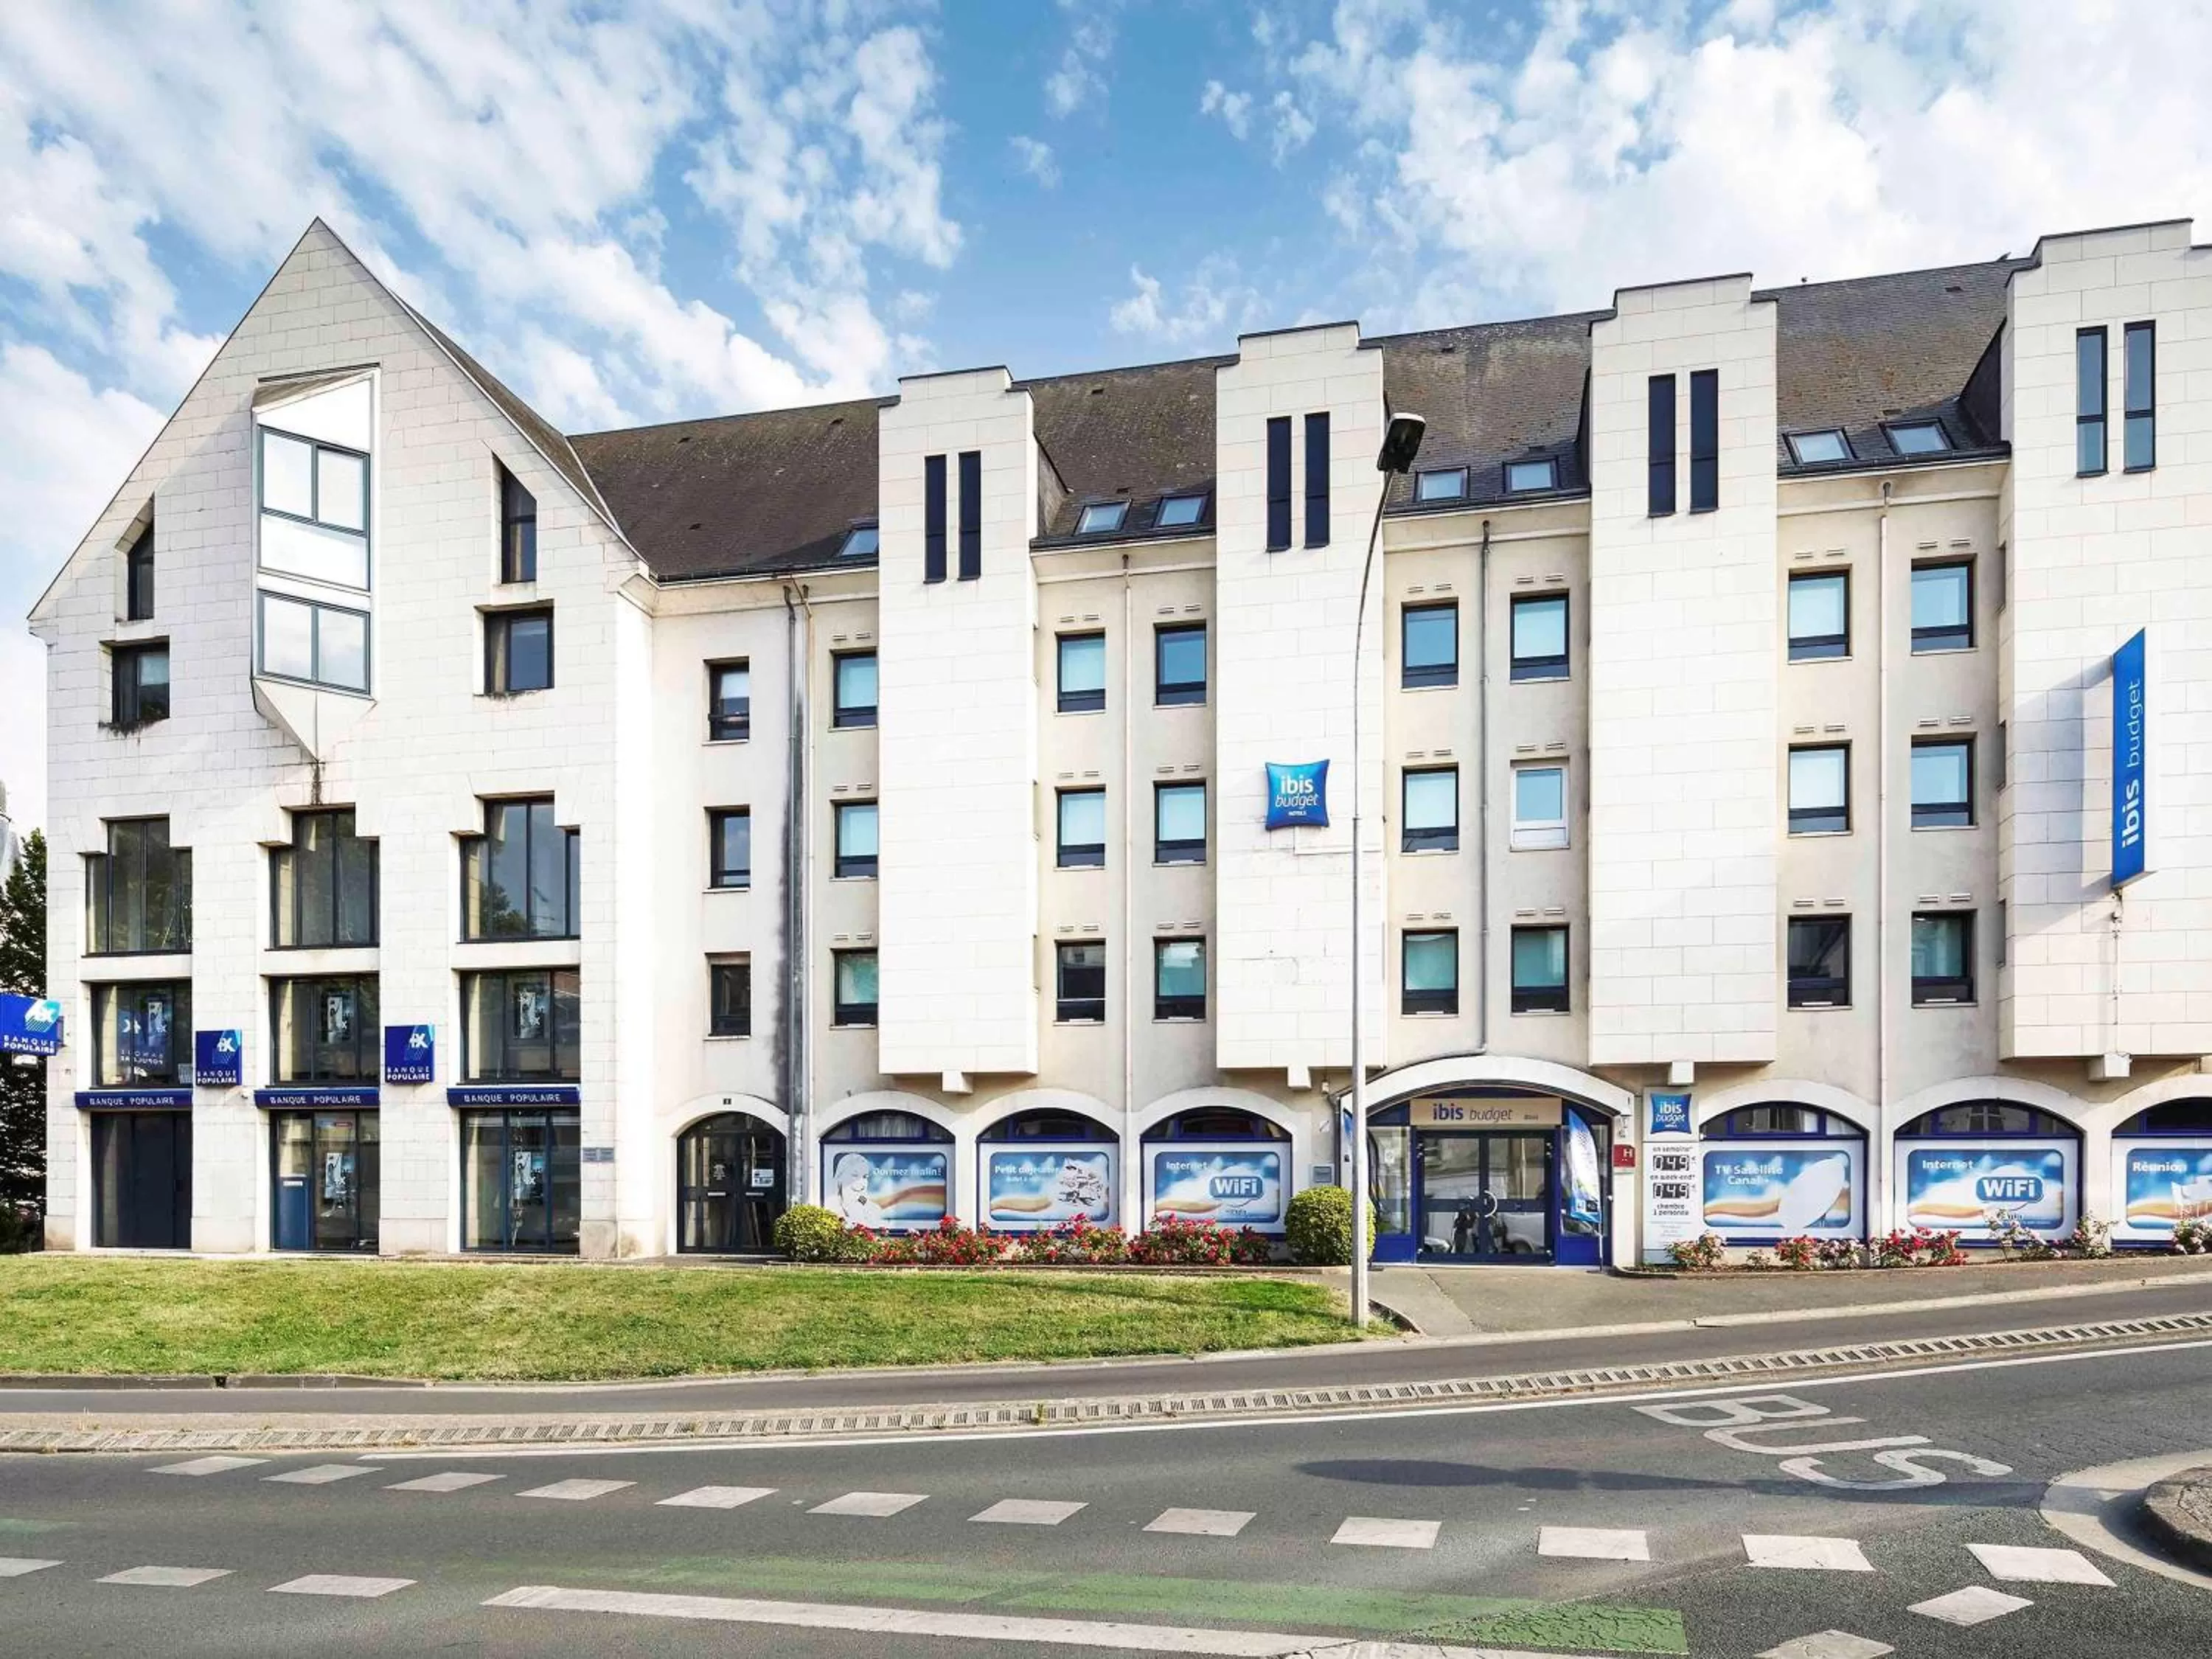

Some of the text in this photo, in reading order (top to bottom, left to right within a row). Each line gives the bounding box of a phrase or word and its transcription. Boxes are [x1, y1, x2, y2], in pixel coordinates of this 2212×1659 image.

[2121, 677, 2144, 849] ibis budget
[1280, 774, 1314, 794] ibis
[1274, 793, 1319, 810] budget
[4, 1034, 55, 1047] BANQUE
[4, 1042, 55, 1054] POPULAIRE
[197, 1069, 237, 1077] BANQUE
[387, 1065, 430, 1074] BANQUE
[89, 1096, 174, 1106] BANQUE POPULAIRE
[270, 1095, 362, 1105] BANQUE POPULAIRE
[464, 1093, 561, 1103] BANQUE POPULAIRE
[1433, 1102, 1514, 1123] ibis budget
[1660, 1101, 1683, 1114] ibis
[1624, 1148, 1633, 1158] H
[995, 1164, 1018, 1174] Petit
[1166, 1161, 1208, 1171] Internet
[1714, 1164, 1784, 1175] TV Satellite
[1922, 1160, 1973, 1169] Internet
[872, 1167, 908, 1176] Dormez
[1214, 1178, 1257, 1194] WiFi
[1983, 1179, 2035, 1198] WiFi
[1630, 1394, 2014, 1491] BUS
